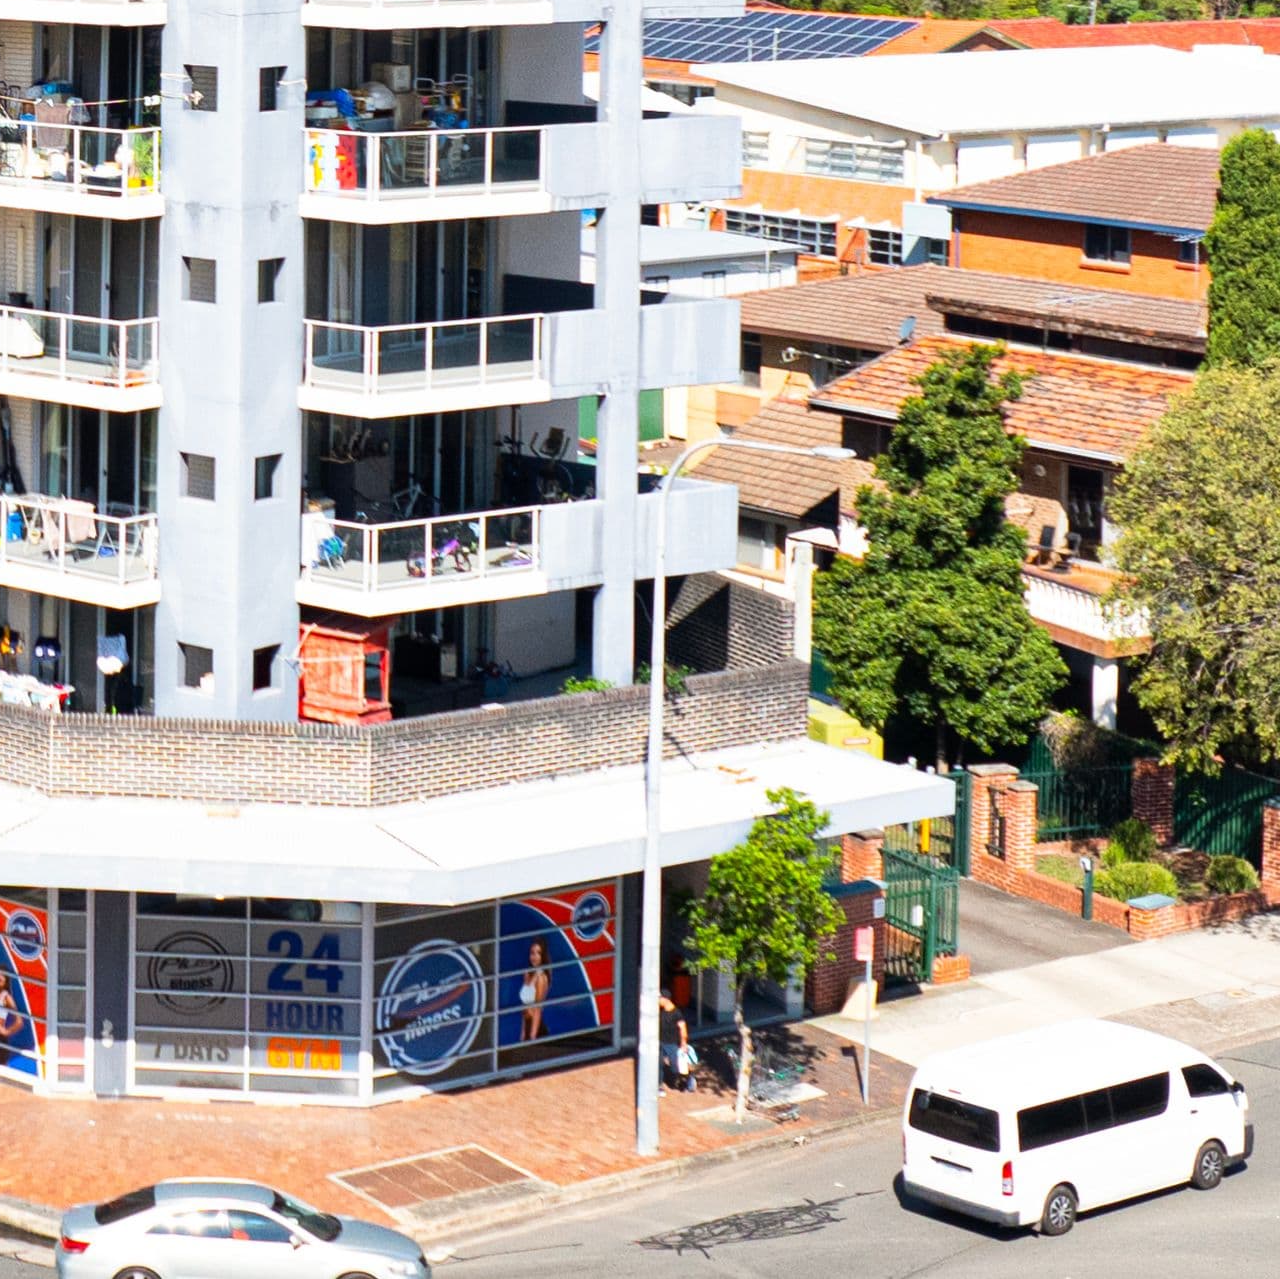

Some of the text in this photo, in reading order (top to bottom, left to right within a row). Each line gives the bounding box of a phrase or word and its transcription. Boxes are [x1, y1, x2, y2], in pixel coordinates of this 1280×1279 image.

[266, 930, 344, 993] 24
[265, 1001, 345, 1033] HOUR
[173, 1035, 230, 1062] DAYS
[266, 1036, 342, 1071] GYM
